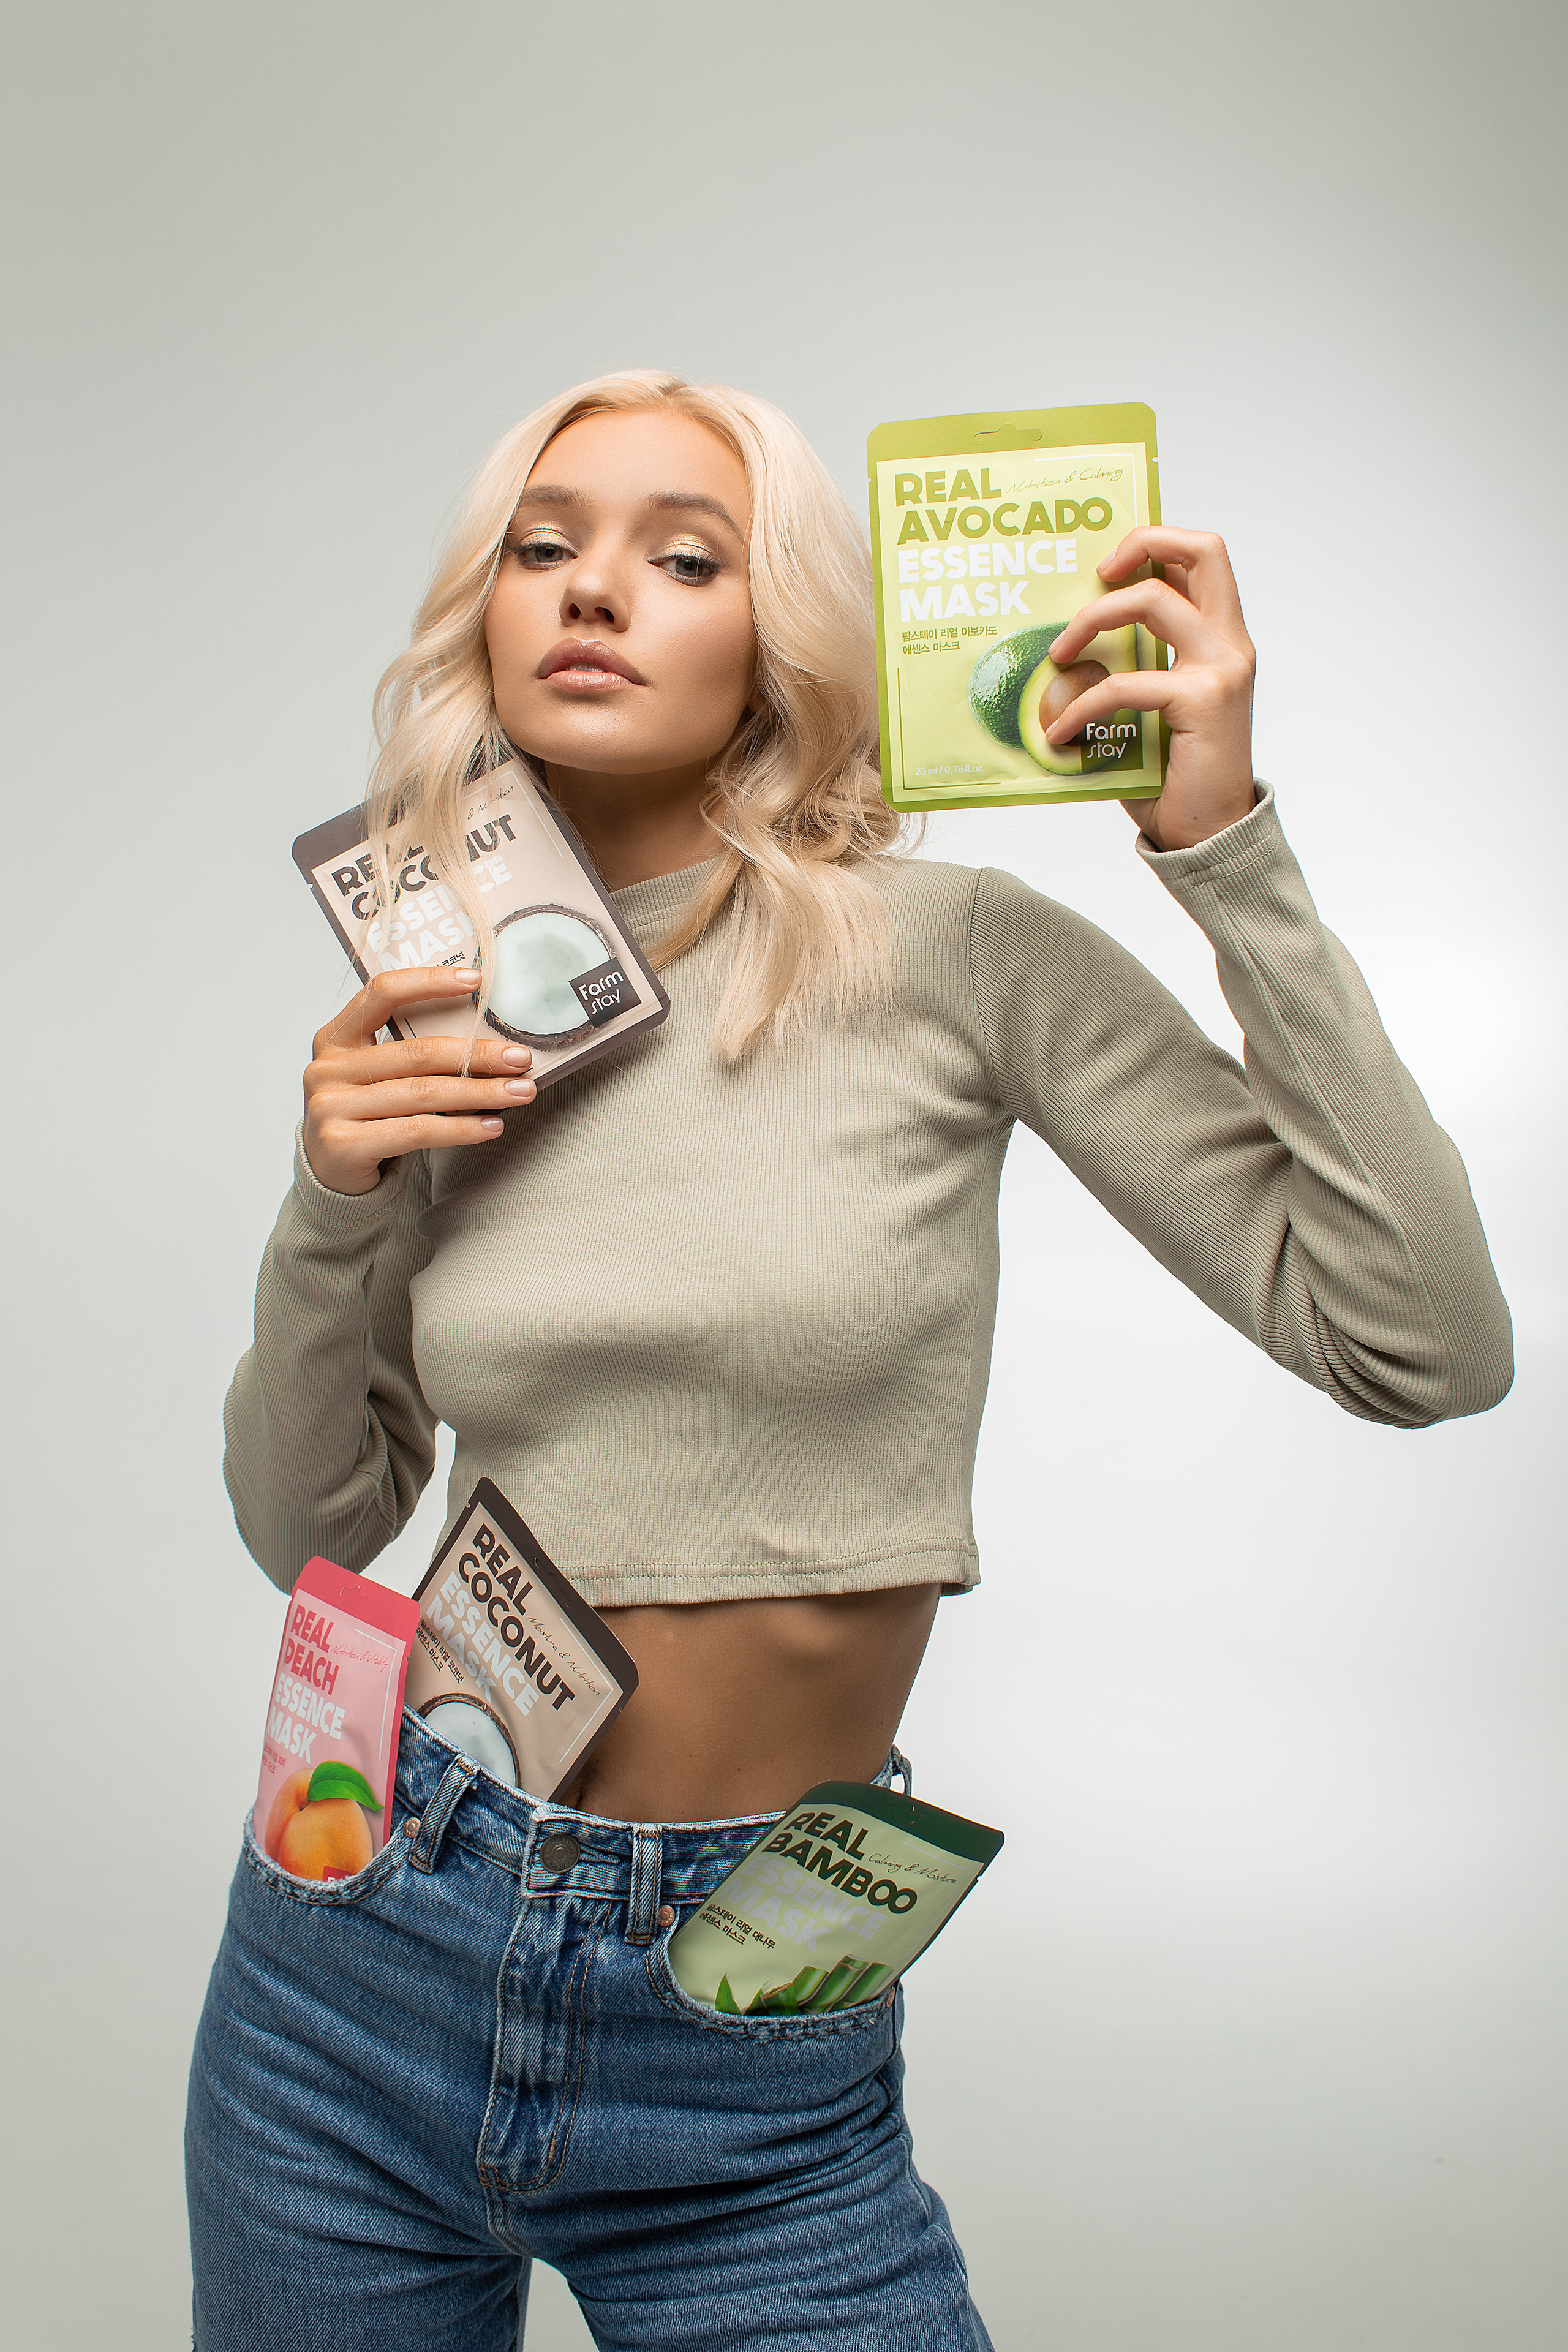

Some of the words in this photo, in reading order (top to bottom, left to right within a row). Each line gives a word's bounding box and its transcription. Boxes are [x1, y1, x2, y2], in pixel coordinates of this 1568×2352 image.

[894, 467, 1002, 507] REAL
[1006, 476, 1061, 494] Nutrition
[1065, 470, 1077, 483] &
[1079, 465, 1123, 482] Calming
[897, 497, 1113, 545] AVOCADO
[897, 538, 1078, 584] ESSENCE
[900, 581, 1033, 623] MASK
[902, 628, 937, 643] 팜스테이
[940, 627, 959, 638] 리얼
[961, 625, 998, 637] 아보카도
[902, 643, 930, 655] 에센스
[933, 641, 961, 652] 마스크
[1086, 723, 1137, 741] Farm
[1087, 742, 1127, 759] stay
[915, 767, 926, 776] 23
[944, 765, 963, 774] 0.78
[578, 971, 624, 1001] Farm
[592, 988, 621, 1016] stay
[472, 1522, 533, 1616] REAL
[290, 1604, 334, 1653] REAL
[417, 1627, 430, 1651] 에센스
[429, 1648, 443, 1672] 마스크
[426, 1594, 498, 1704] MASK
[440, 1570, 540, 1717] ESSENCE
[459, 1552, 576, 1711] COCONUT
[284, 1637, 340, 1695] PEACH
[439, 1646, 450, 1662] 리얼
[448, 1660, 464, 1684] 코코넛
[526, 1617, 557, 1651] Moisture
[566, 1661, 600, 1695] Nutrition
[274, 1672, 345, 1741] ESSENCE
[267, 1705, 317, 1764] MASK
[783, 1812, 869, 1861] REAL
[761, 1832, 918, 1914] BAMBOO
[869, 1853, 902, 1873] Calming
[904, 1863, 919, 1872] &
[717, 1877, 833, 1954] MASK
[738, 1855, 888, 1939] ESSENCE
[699, 1912, 721, 1929] 에센스
[722, 1924, 746, 1945] 마스크
[736, 1919, 753, 1936] 리얼
[752, 1930, 776, 1949] 대나무
